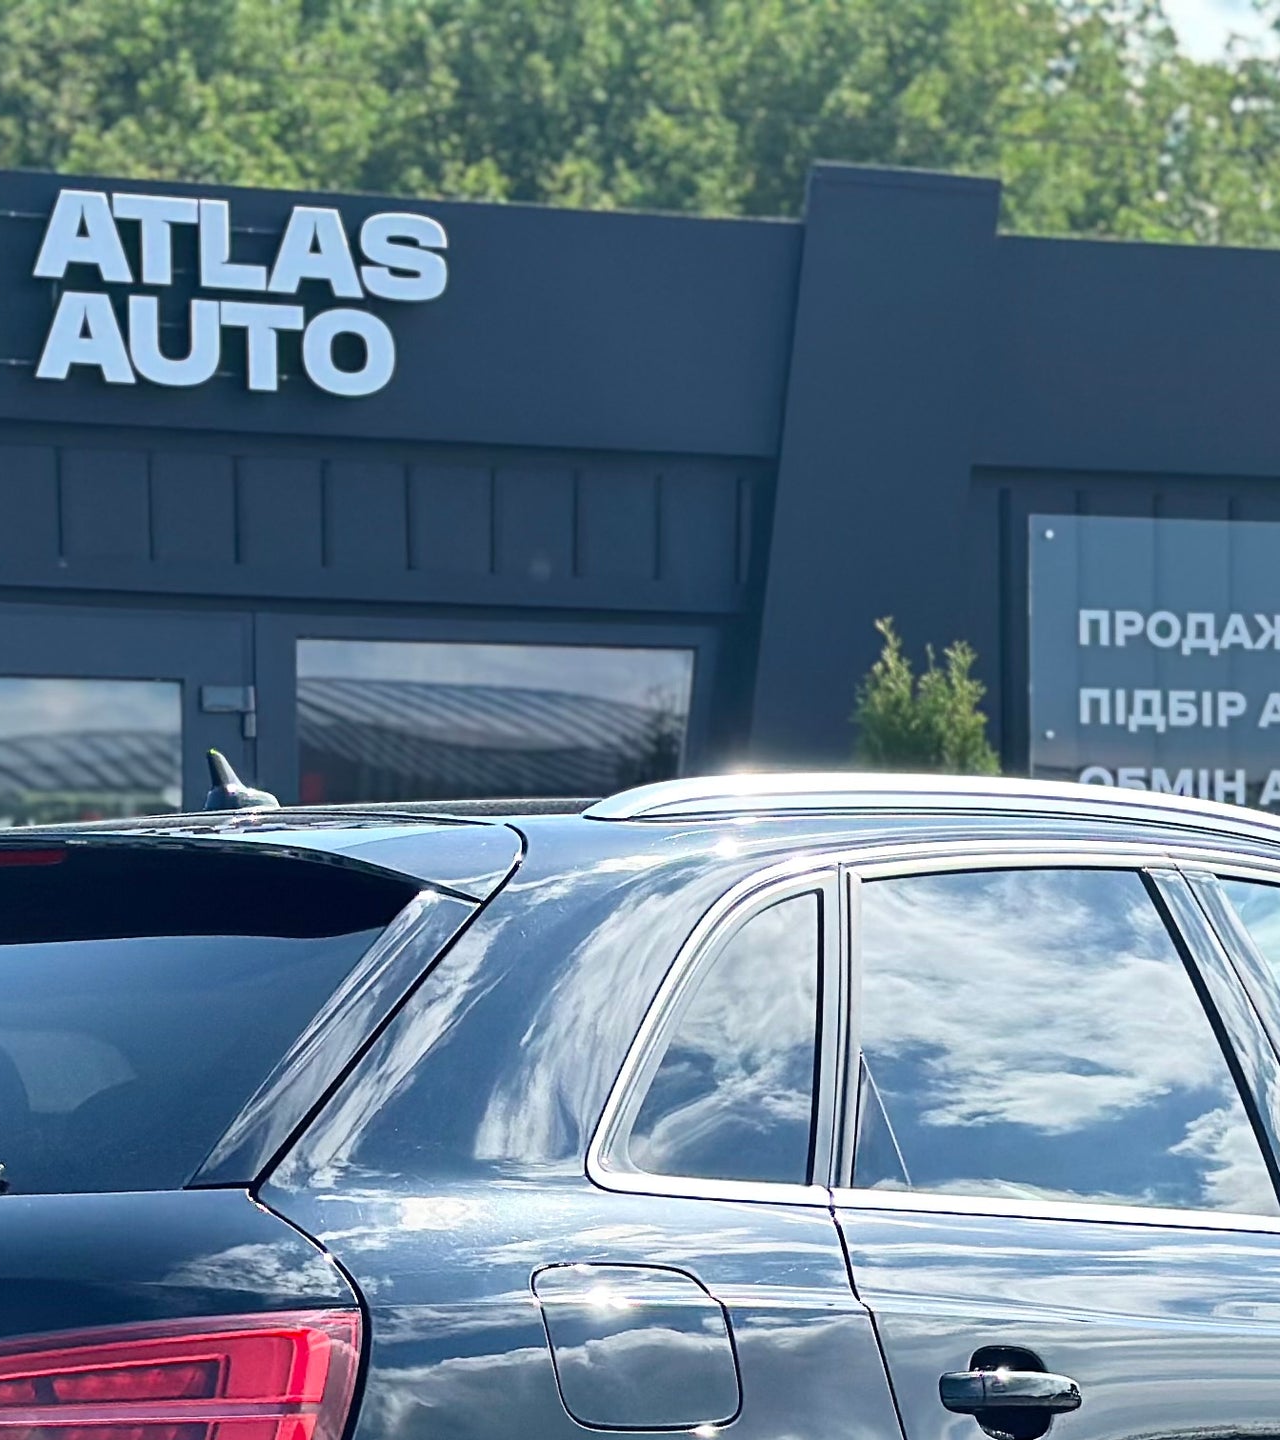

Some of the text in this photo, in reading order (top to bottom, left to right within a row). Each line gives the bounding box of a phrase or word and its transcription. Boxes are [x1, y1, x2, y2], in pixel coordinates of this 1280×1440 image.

[33, 189, 449, 302] ATLAS
[35, 291, 396, 397] AUTO
[1078, 688, 1247, 733] ПІДБІР
